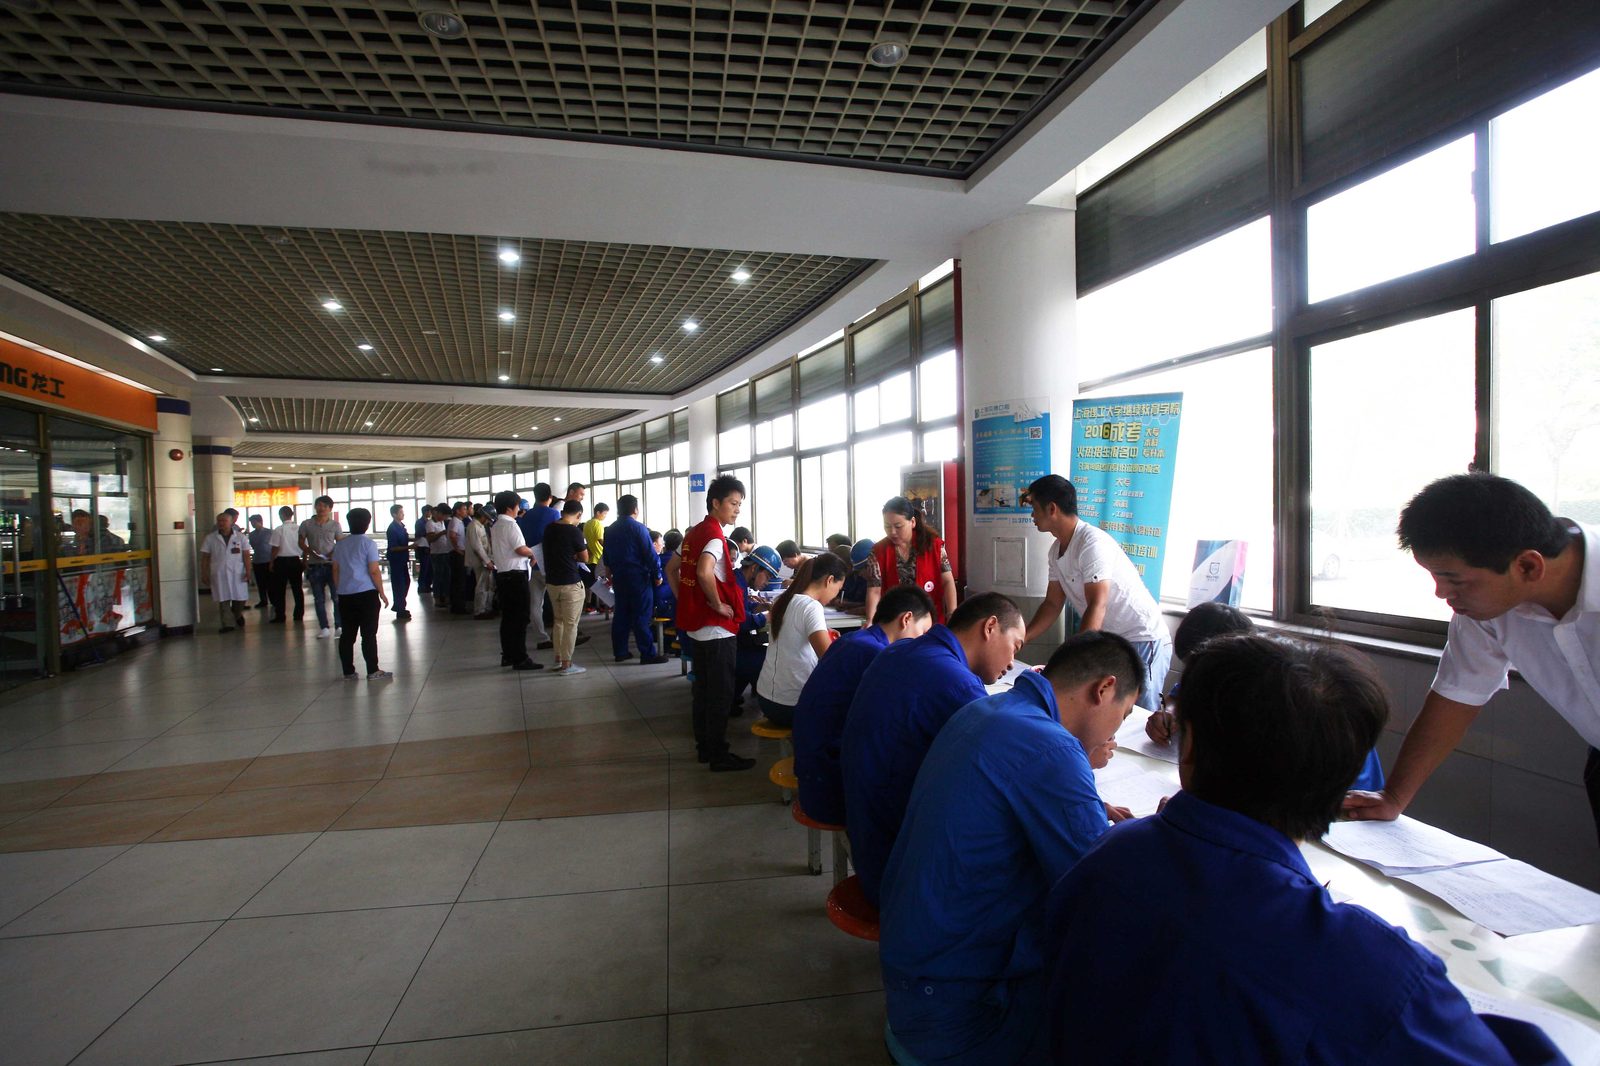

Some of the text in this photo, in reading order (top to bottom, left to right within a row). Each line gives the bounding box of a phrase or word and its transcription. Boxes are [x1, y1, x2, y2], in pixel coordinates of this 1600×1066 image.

[31, 372, 65, 398] 龙工
[1073, 402, 1181, 420] 上海理工大学继续教育学院
[1084, 421, 1142, 442] 2016成考
[1076, 446, 1139, 459] 火热招生报名中
